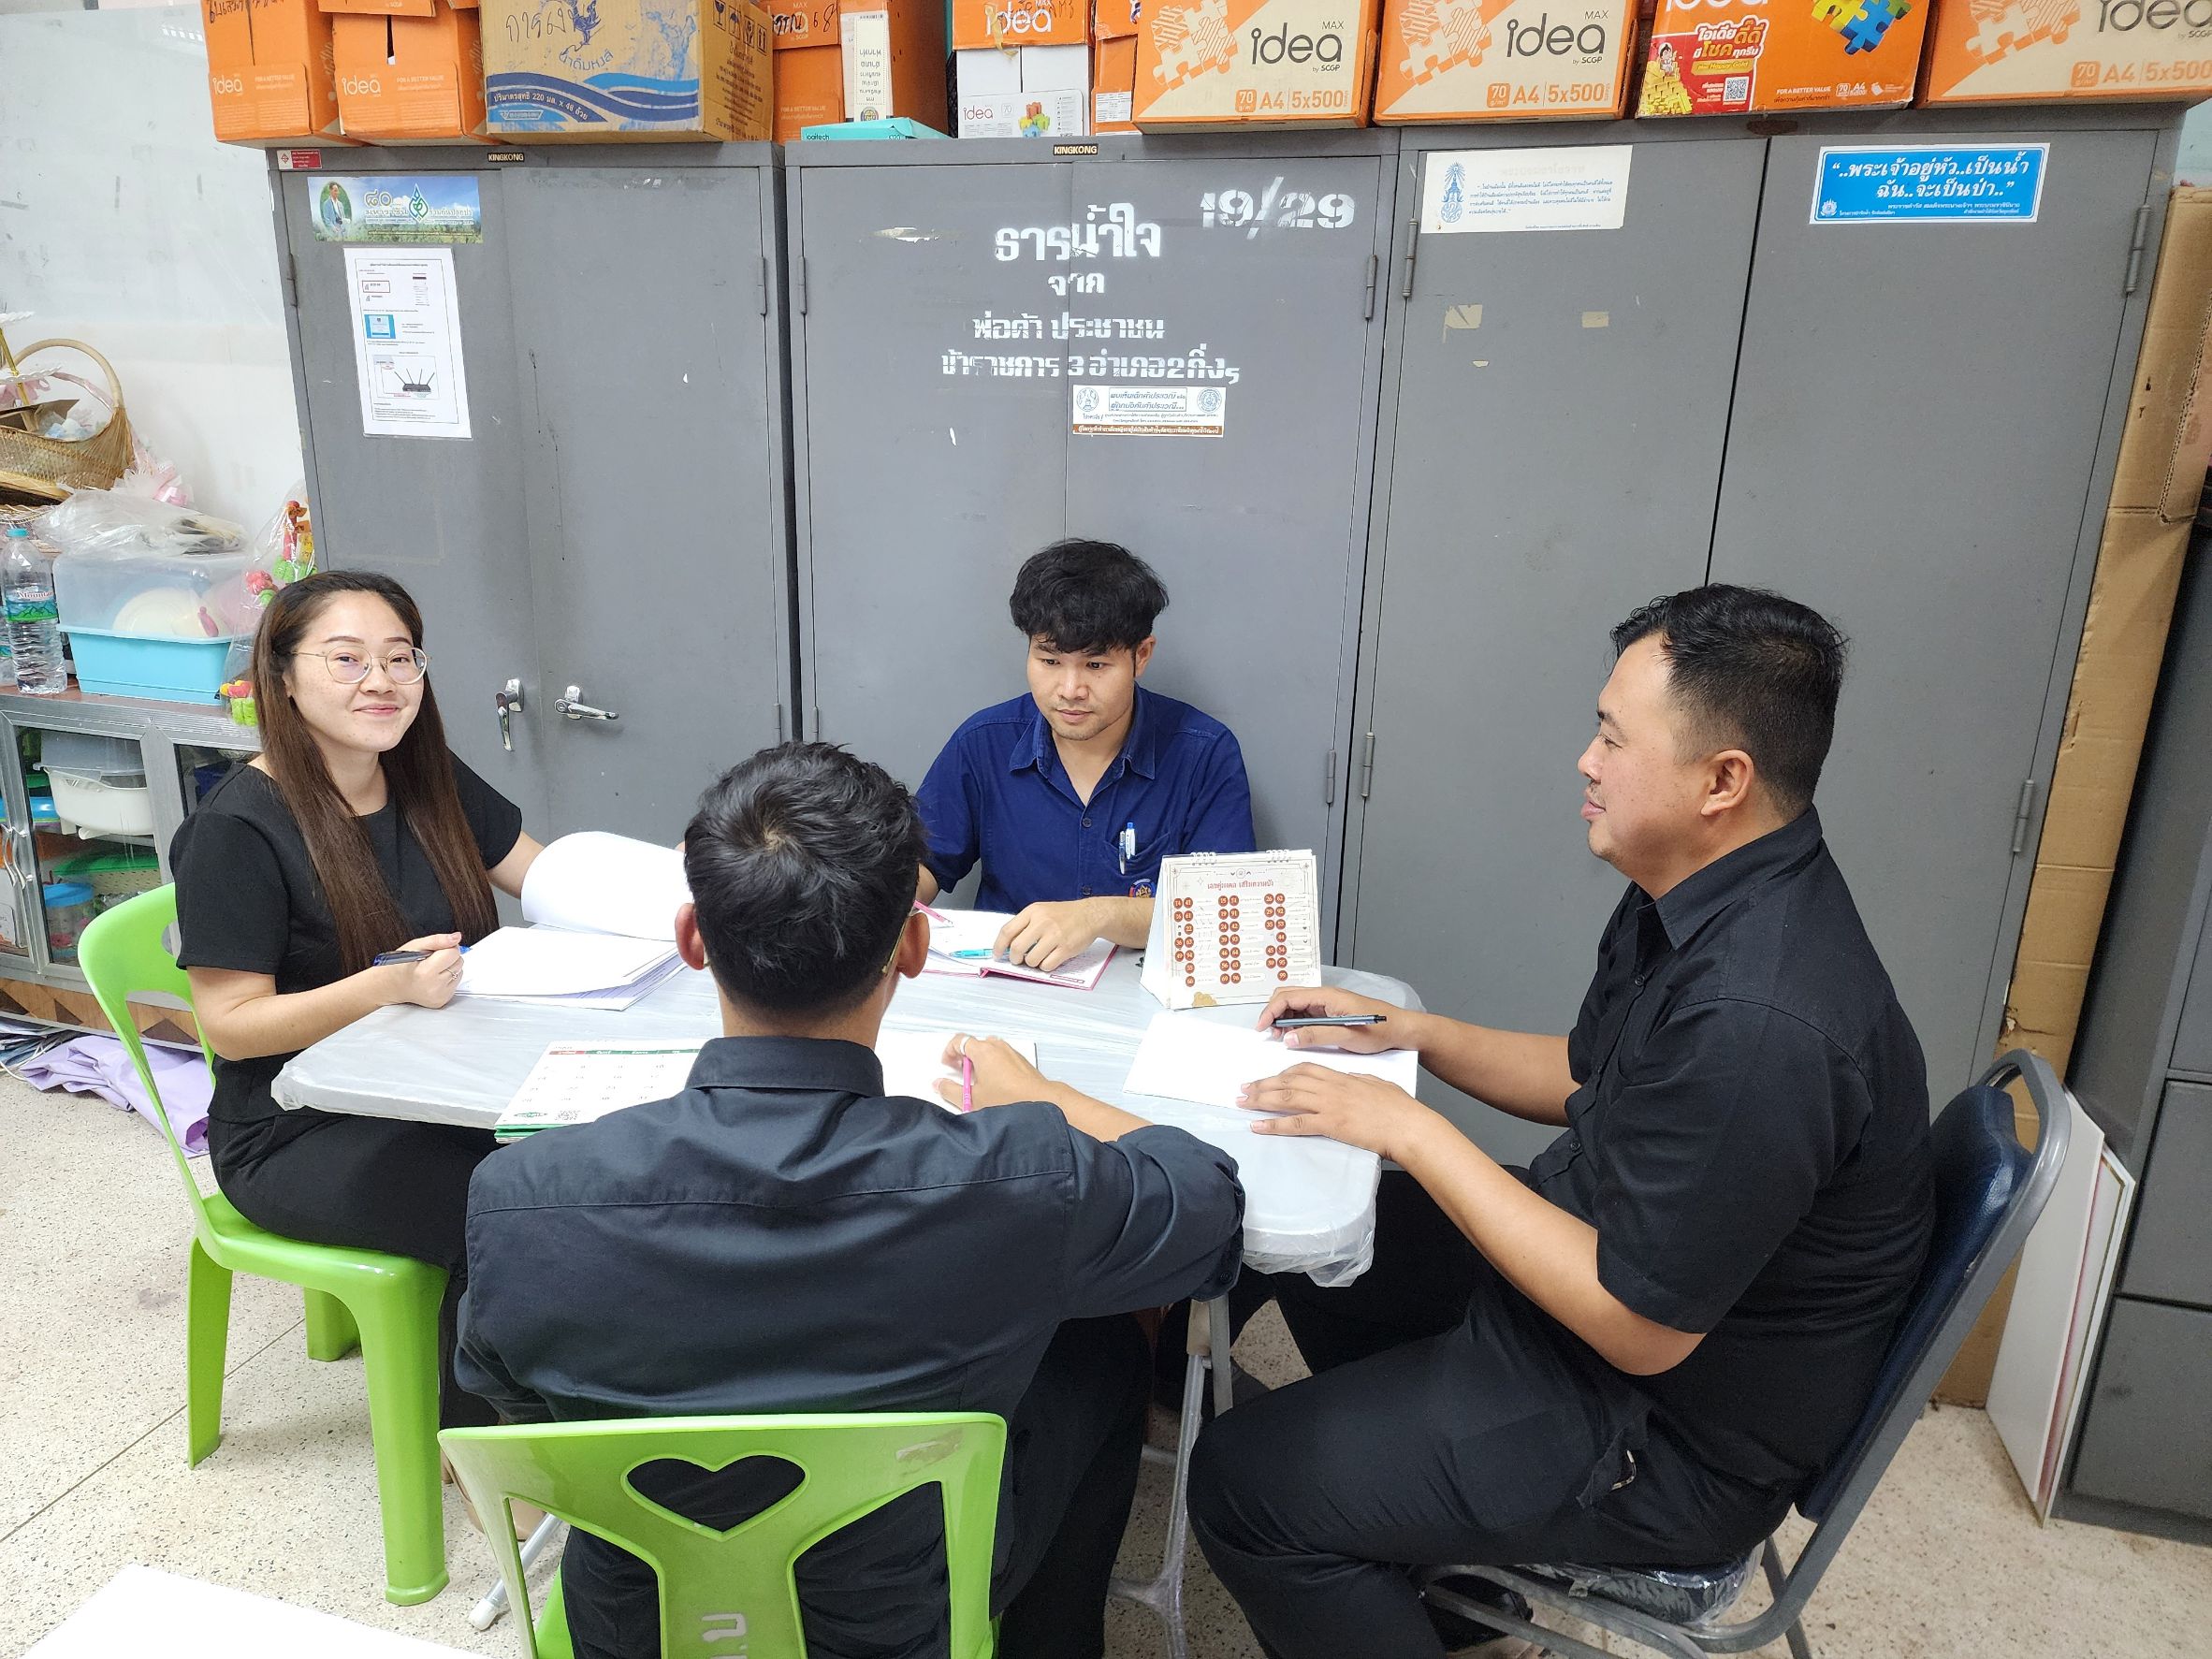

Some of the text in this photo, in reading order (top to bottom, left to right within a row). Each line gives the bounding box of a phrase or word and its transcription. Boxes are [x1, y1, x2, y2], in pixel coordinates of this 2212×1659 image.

[1584, 9, 1608, 20] MAX
[1321, 21, 1344, 30] MAX
[1506, 13, 1606, 57] idea
[1251, 22, 1342, 65] idea
[2076, 65, 2097, 78] 70
[2103, 62, 2134, 82] A4
[212, 75, 242, 95] idea
[342, 75, 381, 95] idea
[1491, 83, 1604, 104] 70 A4 5x500
[1239, 90, 1344, 109] 70 A4 5x500
[963, 106, 994, 121] idea
[488, 153, 524, 162] KINGKONG
[1054, 145, 1098, 154] KINGKONG
[1201, 177, 1355, 240] 19/29
[995, 202, 1161, 262] ธารน้ำใจ
[1047, 272, 1105, 296] จาก
[972, 311, 1165, 340] พ่อค้า ประชาชน
